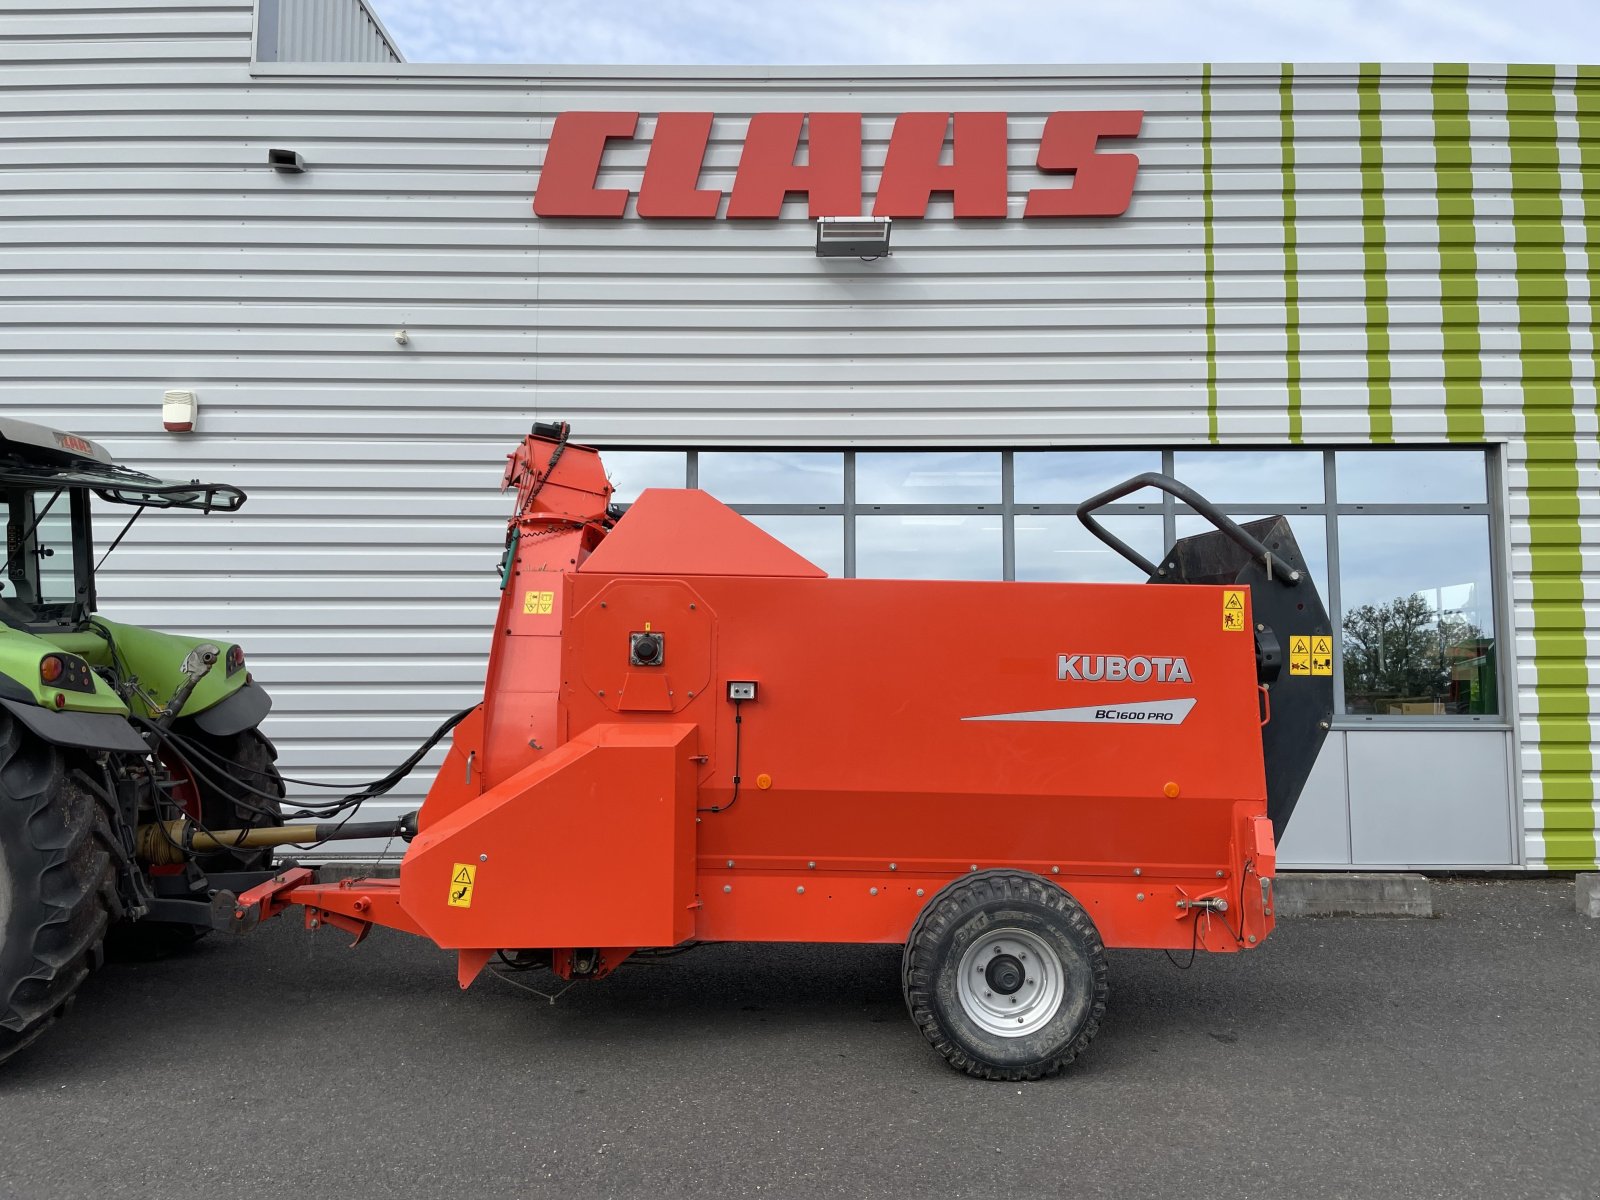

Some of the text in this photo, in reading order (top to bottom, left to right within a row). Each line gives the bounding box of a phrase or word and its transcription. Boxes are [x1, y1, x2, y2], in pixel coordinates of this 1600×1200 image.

[533, 111, 1144, 219] CLAAS
[1057, 655, 1193, 683] KUBOTA
[1095, 709, 1174, 721] BC1600 PRO
